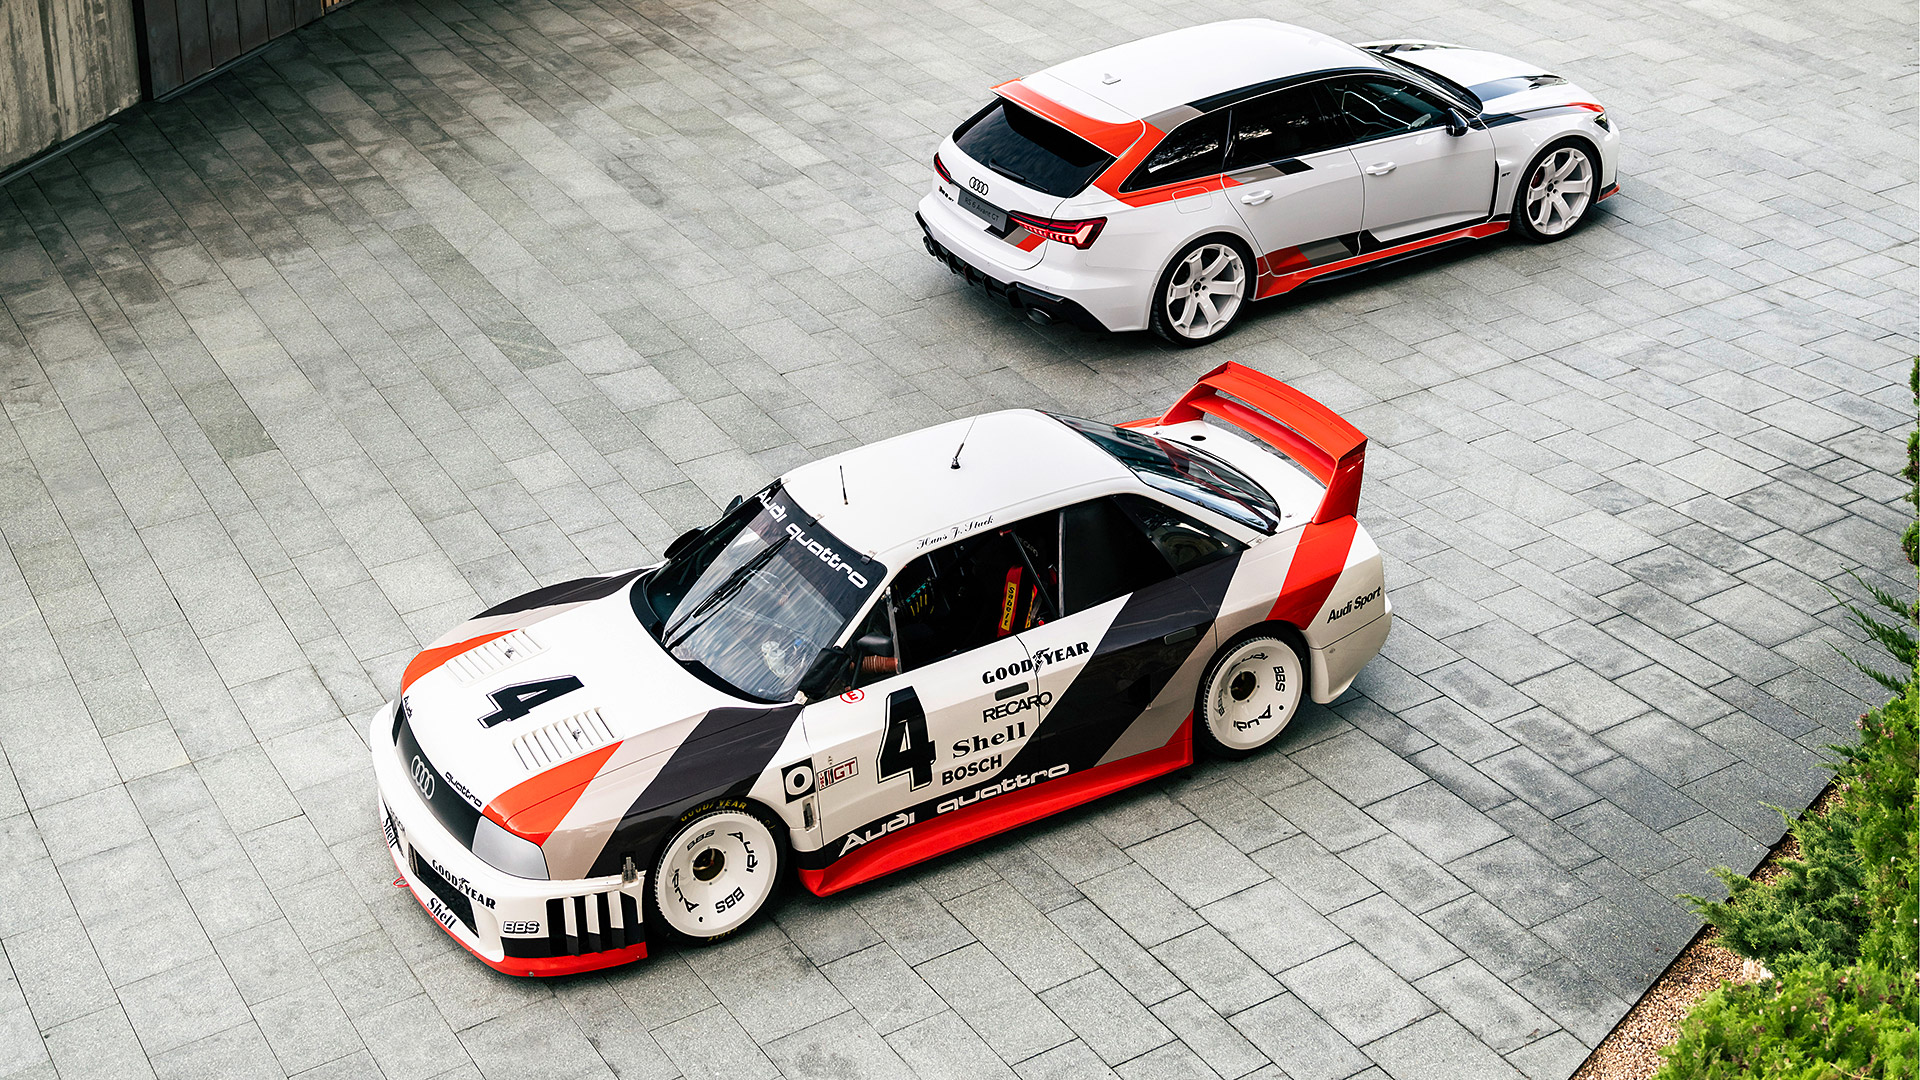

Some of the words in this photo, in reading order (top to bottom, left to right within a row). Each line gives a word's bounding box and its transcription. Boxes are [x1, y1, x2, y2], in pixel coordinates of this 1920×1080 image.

[755, 488, 787, 523] Audi
[785, 522, 868, 589] quattro
[917, 534, 947, 549] Hans
[1327, 600, 1352, 624] Audi
[1354, 586, 1381, 609] Sport
[1273, 666, 1286, 692] BBS
[477, 674, 585, 729] 4
[982, 691, 1053, 723] RECARO
[1233, 703, 1272, 732] Audi
[876, 685, 937, 792] 4
[952, 721, 1027, 759] Shell
[942, 754, 1003, 786] BOSCH
[445, 771, 483, 808] quattro
[838, 812, 915, 857] Audi
[936, 763, 1070, 814] quattro
[727, 831, 758, 873] Audi
[672, 868, 699, 913] Audi
[715, 886, 745, 914] BBS
[427, 897, 457, 929] Shell
[503, 921, 540, 934] BBS
